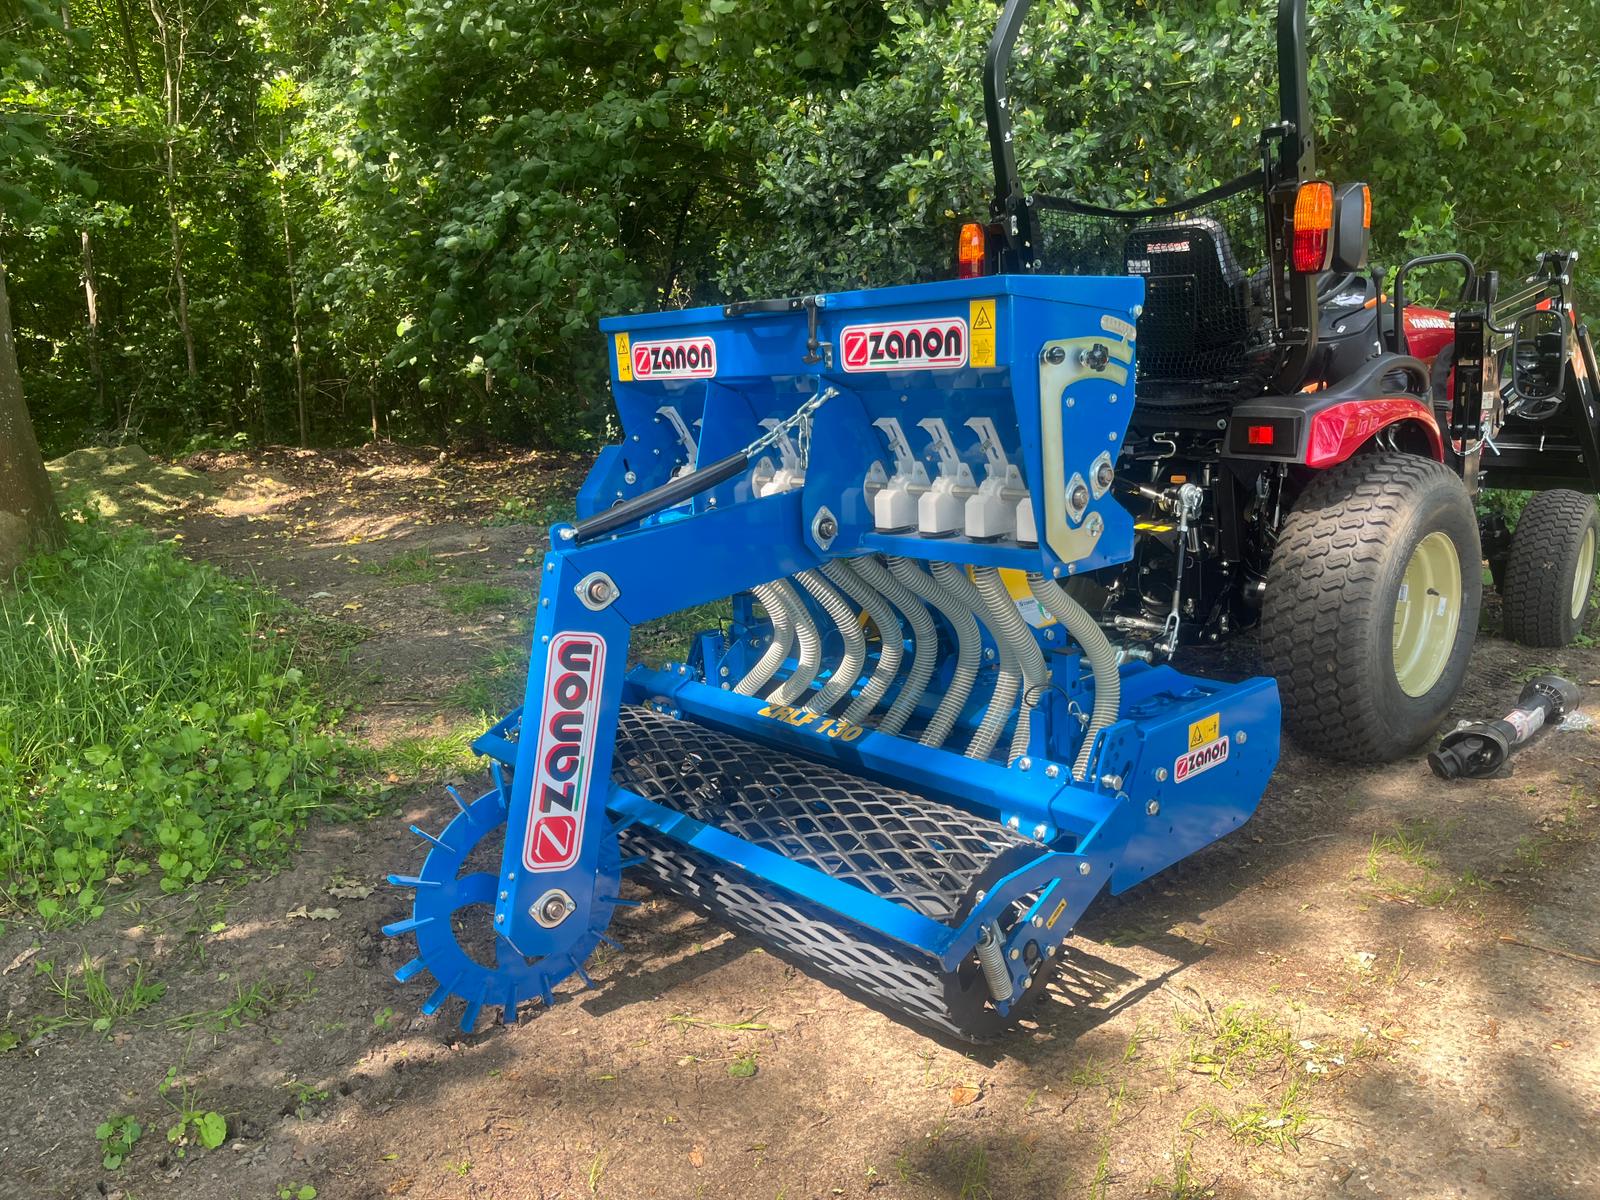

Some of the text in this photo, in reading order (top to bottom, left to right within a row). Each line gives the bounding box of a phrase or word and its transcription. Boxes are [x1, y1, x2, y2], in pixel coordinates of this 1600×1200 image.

[1408, 318, 1447, 329] YANMAR
[757, 704, 864, 742] ZRLF 130
